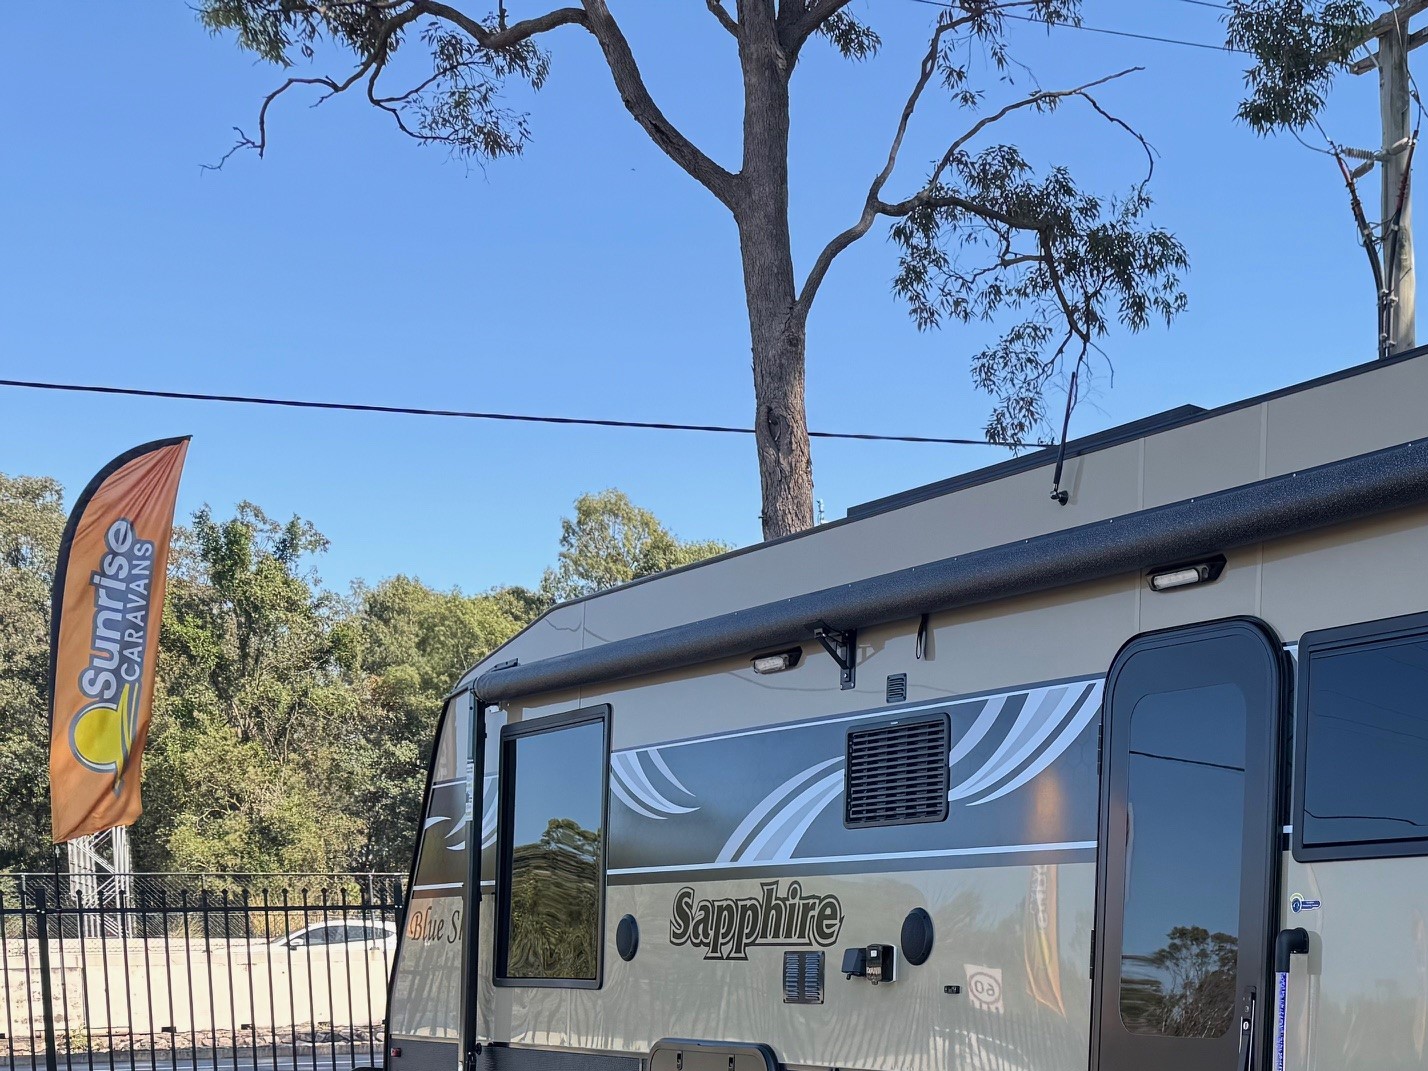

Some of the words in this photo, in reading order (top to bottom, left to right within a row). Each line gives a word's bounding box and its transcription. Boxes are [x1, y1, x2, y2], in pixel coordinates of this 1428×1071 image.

[82, 519, 133, 699] Sunrise
[120, 542, 153, 681] CARAVANS
[409, 905, 445, 942] Blue
[669, 879, 846, 961] Sapphire
